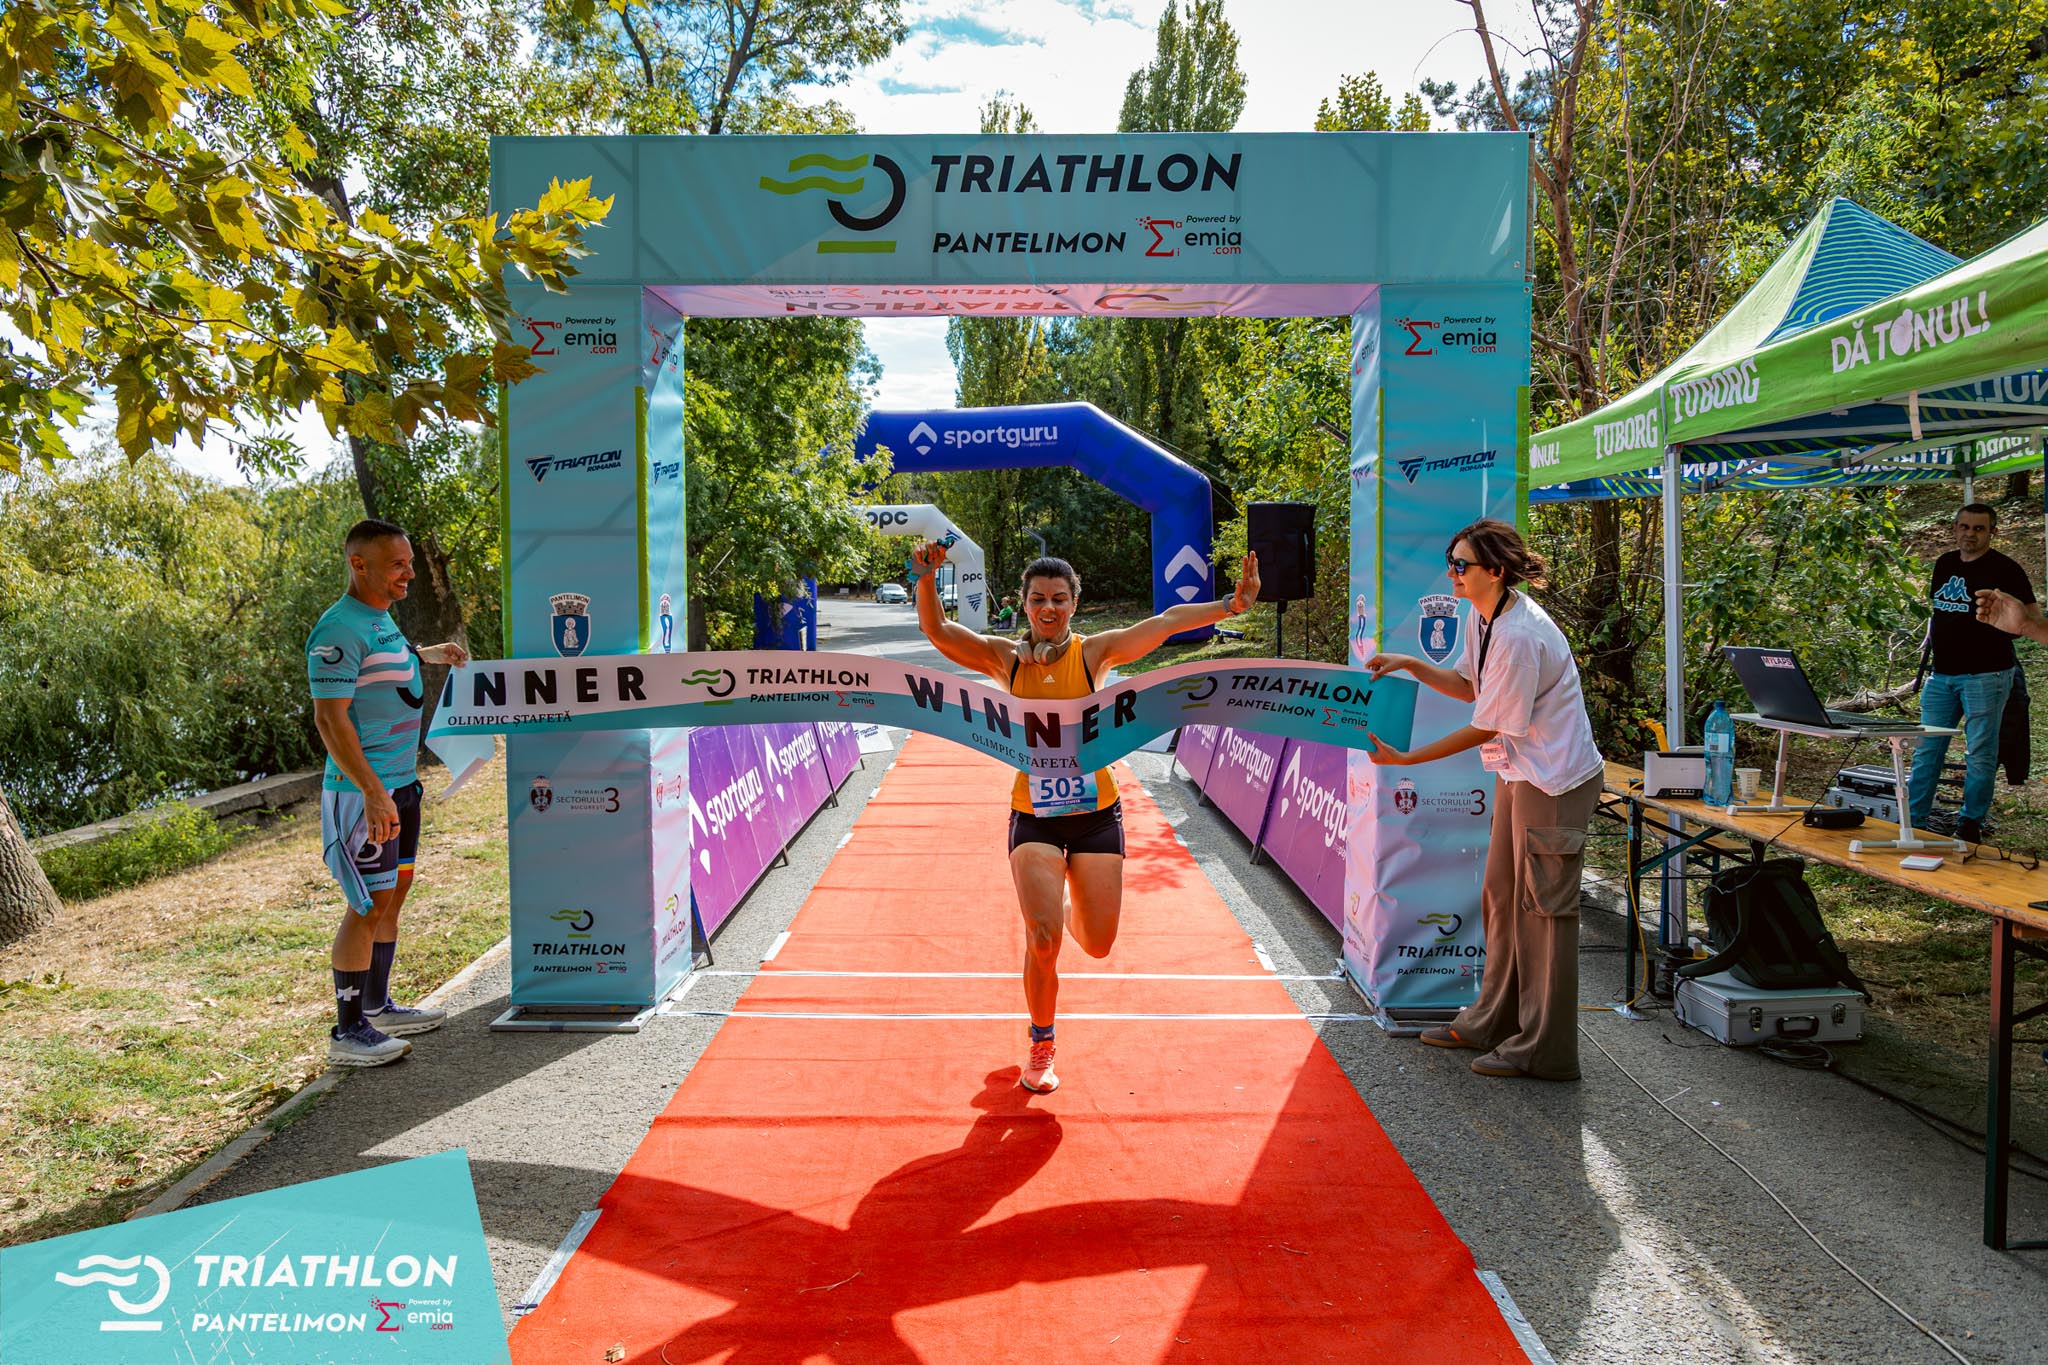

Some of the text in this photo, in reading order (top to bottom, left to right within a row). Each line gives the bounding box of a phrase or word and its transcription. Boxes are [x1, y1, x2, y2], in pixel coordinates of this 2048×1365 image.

[931, 153, 1242, 192] TRIATHLON
[1186, 214, 1241, 225] Powered by
[932, 232, 1126, 253] PANTELIMON
[1184, 227, 1242, 246] emia
[1213, 245, 1242, 255] .com
[565, 317, 616, 327] Powered by
[1444, 316, 1496, 325] Powered by
[564, 329, 617, 346] emia
[1442, 328, 1497, 345] emia
[590, 345, 617, 354] .com
[1471, 345, 1497, 353] .com
[1831, 319, 1870, 374] DĂ
[1669, 357, 1760, 424] TUBORG
[944, 426, 1058, 448] sportguru
[1593, 407, 1658, 460] TUBORG
[554, 450, 622, 472] TRIATLON
[586, 461, 621, 472] ROMANIA
[1426, 450, 1497, 472] TRIATLON
[1460, 462, 1495, 473] ROMANIA
[962, 573, 983, 583] ppc
[550, 594, 590, 604] PANTELIMON
[1420, 596, 1460, 605] PANTELIMON
[1761, 657, 1792, 665] MYLAPS
[747, 668, 869, 688] TRIATHLON
[750, 693, 830, 703] PANTELIMON
[1231, 675, 1373, 706] TRIATHLON
[852, 696, 875, 705] emia
[1227, 698, 1316, 718] PANTELIMON
[904, 673, 1137, 748] WINNER
[447, 714, 509, 726] OLIMPIC
[1341, 714, 1368, 727] emia
[971, 732, 1016, 758] OLIMPIC
[778, 728, 816, 780] sportguru
[1231, 734, 1274, 784] sportguru
[1040, 776, 1086, 799] 503
[556, 795, 605, 803] SECTORULUI
[604, 787, 620, 813] 3
[706, 766, 764, 841] sportguru
[1421, 798, 1471, 806] SECTORULUI
[1470, 789, 1486, 816] 3
[532, 943, 625, 956] TRIATHLON
[1397, 945, 1487, 959] TRIATHLON
[533, 965, 592, 973] PANTELIMON
[1397, 967, 1455, 976] PANTELIMON
